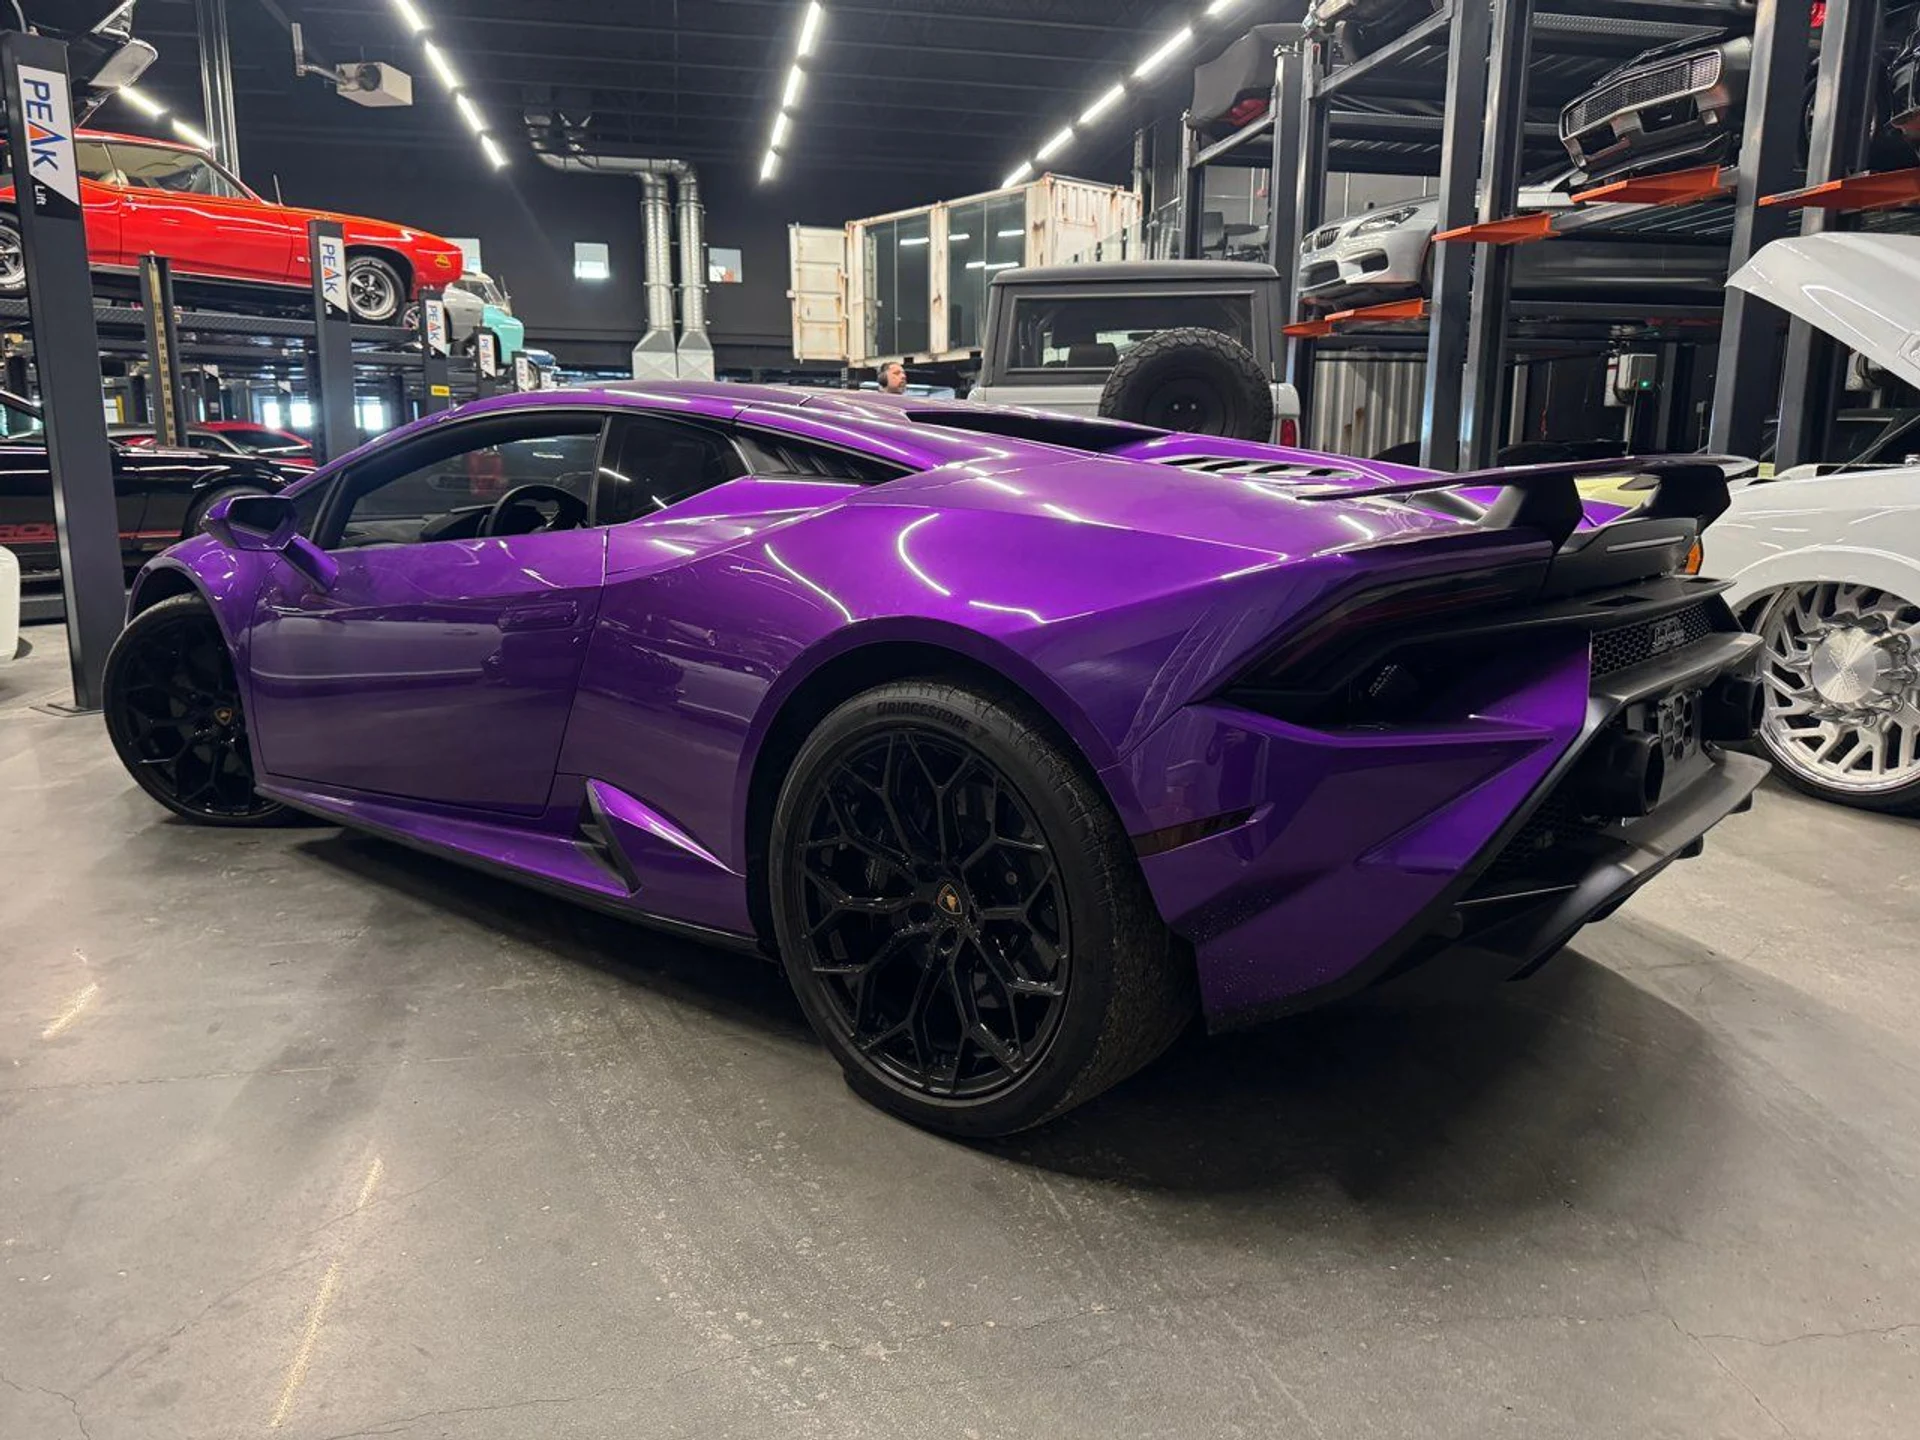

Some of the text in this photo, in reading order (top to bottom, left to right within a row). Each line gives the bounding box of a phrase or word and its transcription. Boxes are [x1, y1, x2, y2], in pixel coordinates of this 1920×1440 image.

[23, 78, 68, 171] PEAK
[322, 243, 342, 294] PEAK
[428, 304, 441, 342] PEAK
